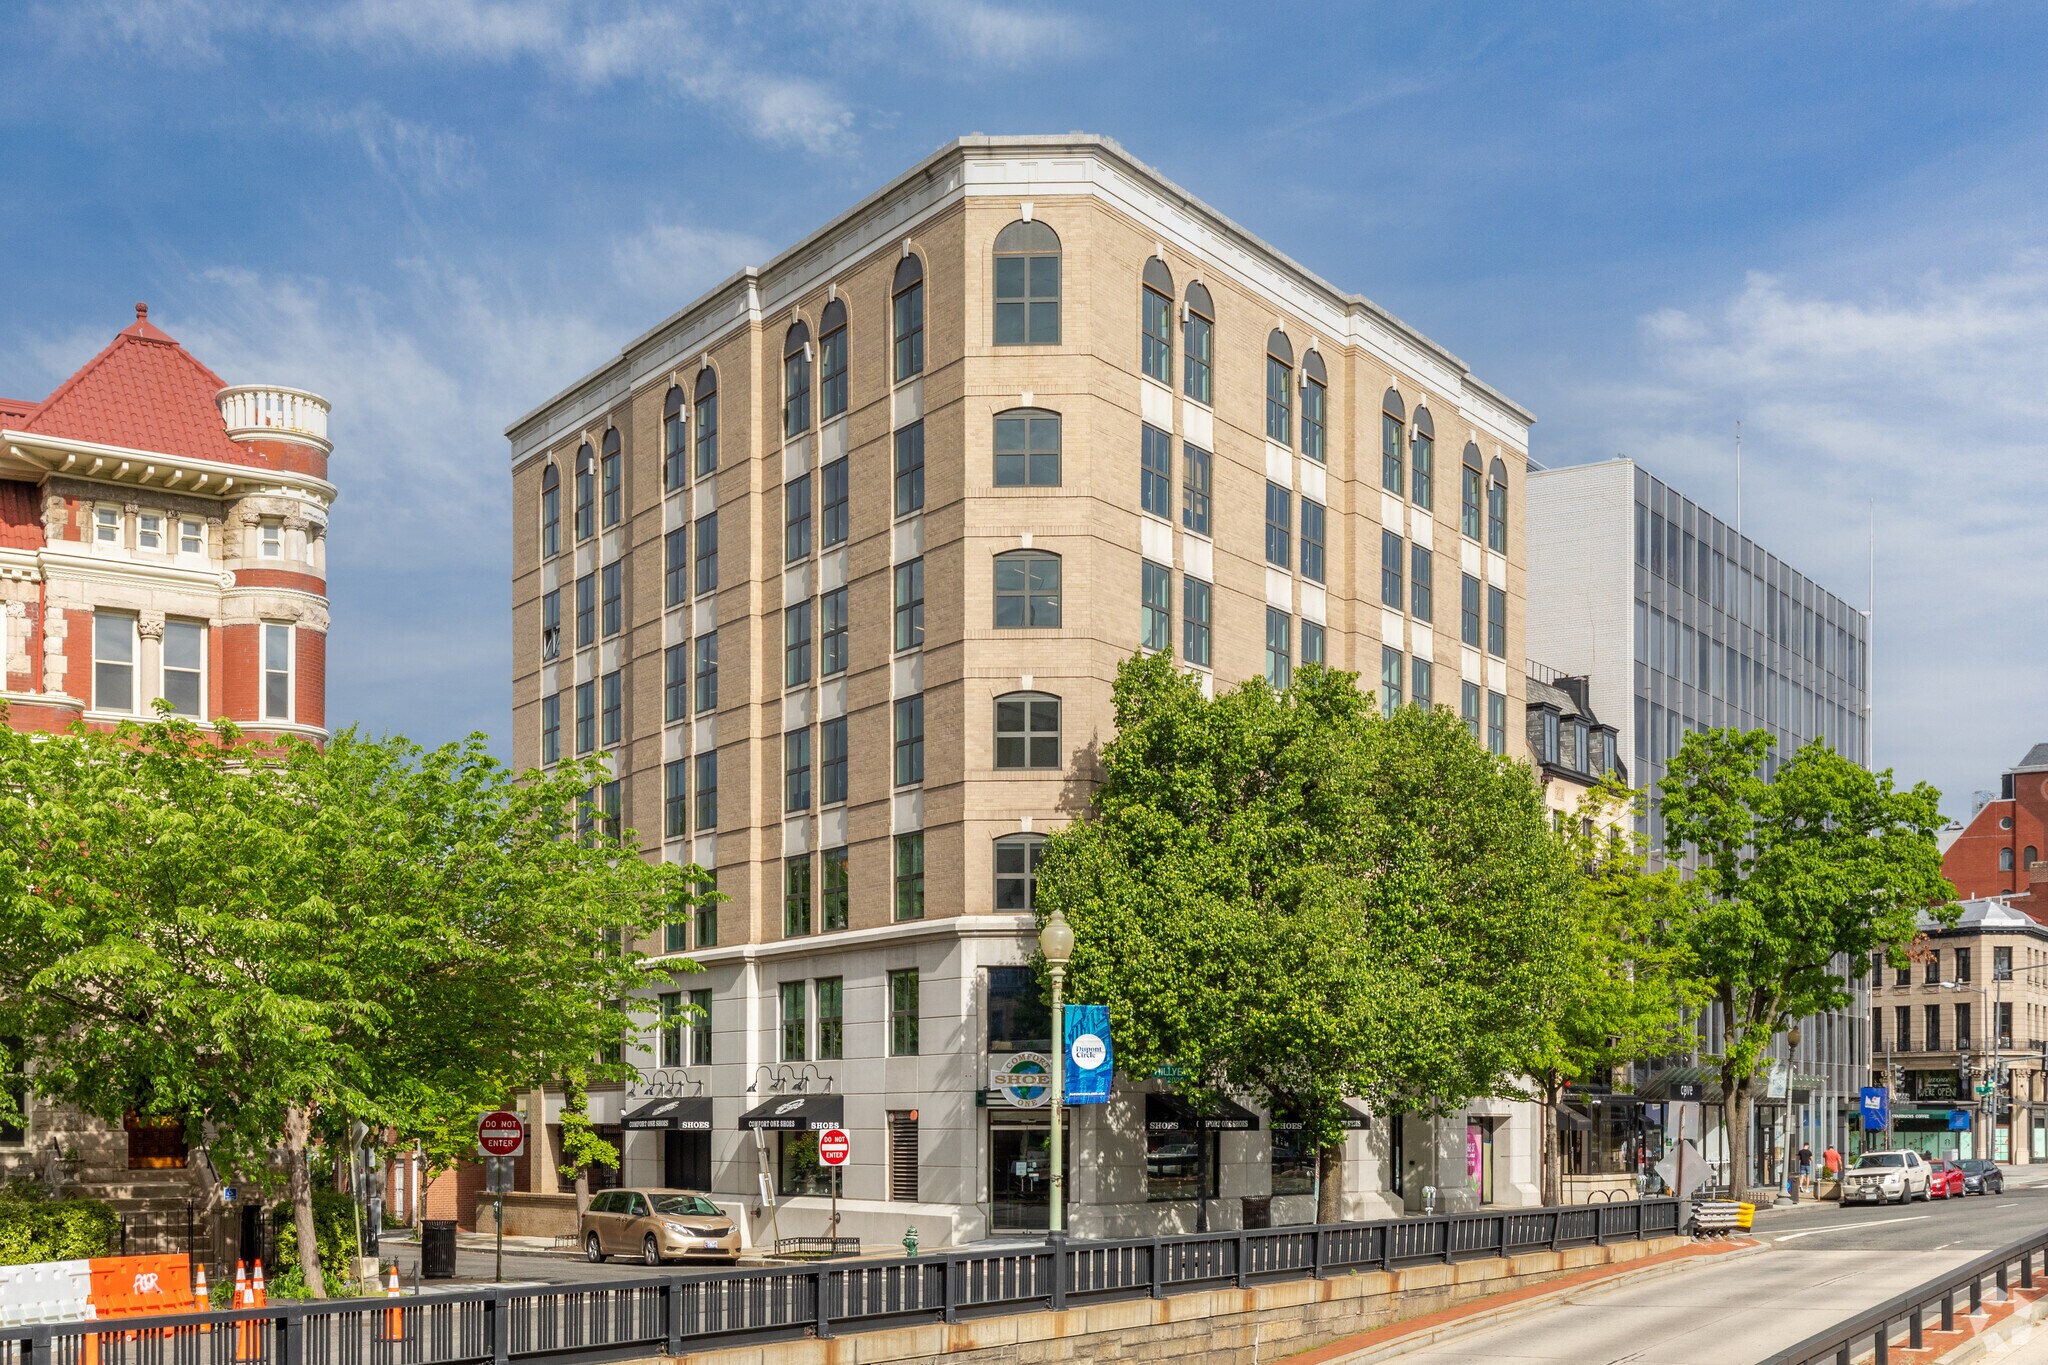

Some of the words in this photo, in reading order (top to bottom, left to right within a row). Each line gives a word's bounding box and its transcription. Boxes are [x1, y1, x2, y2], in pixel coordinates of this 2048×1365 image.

[1076, 1045, 1102, 1053] Dupont
[1006, 1053, 1051, 1069] COMFORT
[994, 1075, 1050, 1085] SHOE
[682, 1121, 710, 1129] SHOES
[780, 1120, 795, 1128] SHOES
[810, 1121, 840, 1130] SHOES
[1149, 1121, 1179, 1130] SHOES
[1280, 1122, 1302, 1130] HOES
